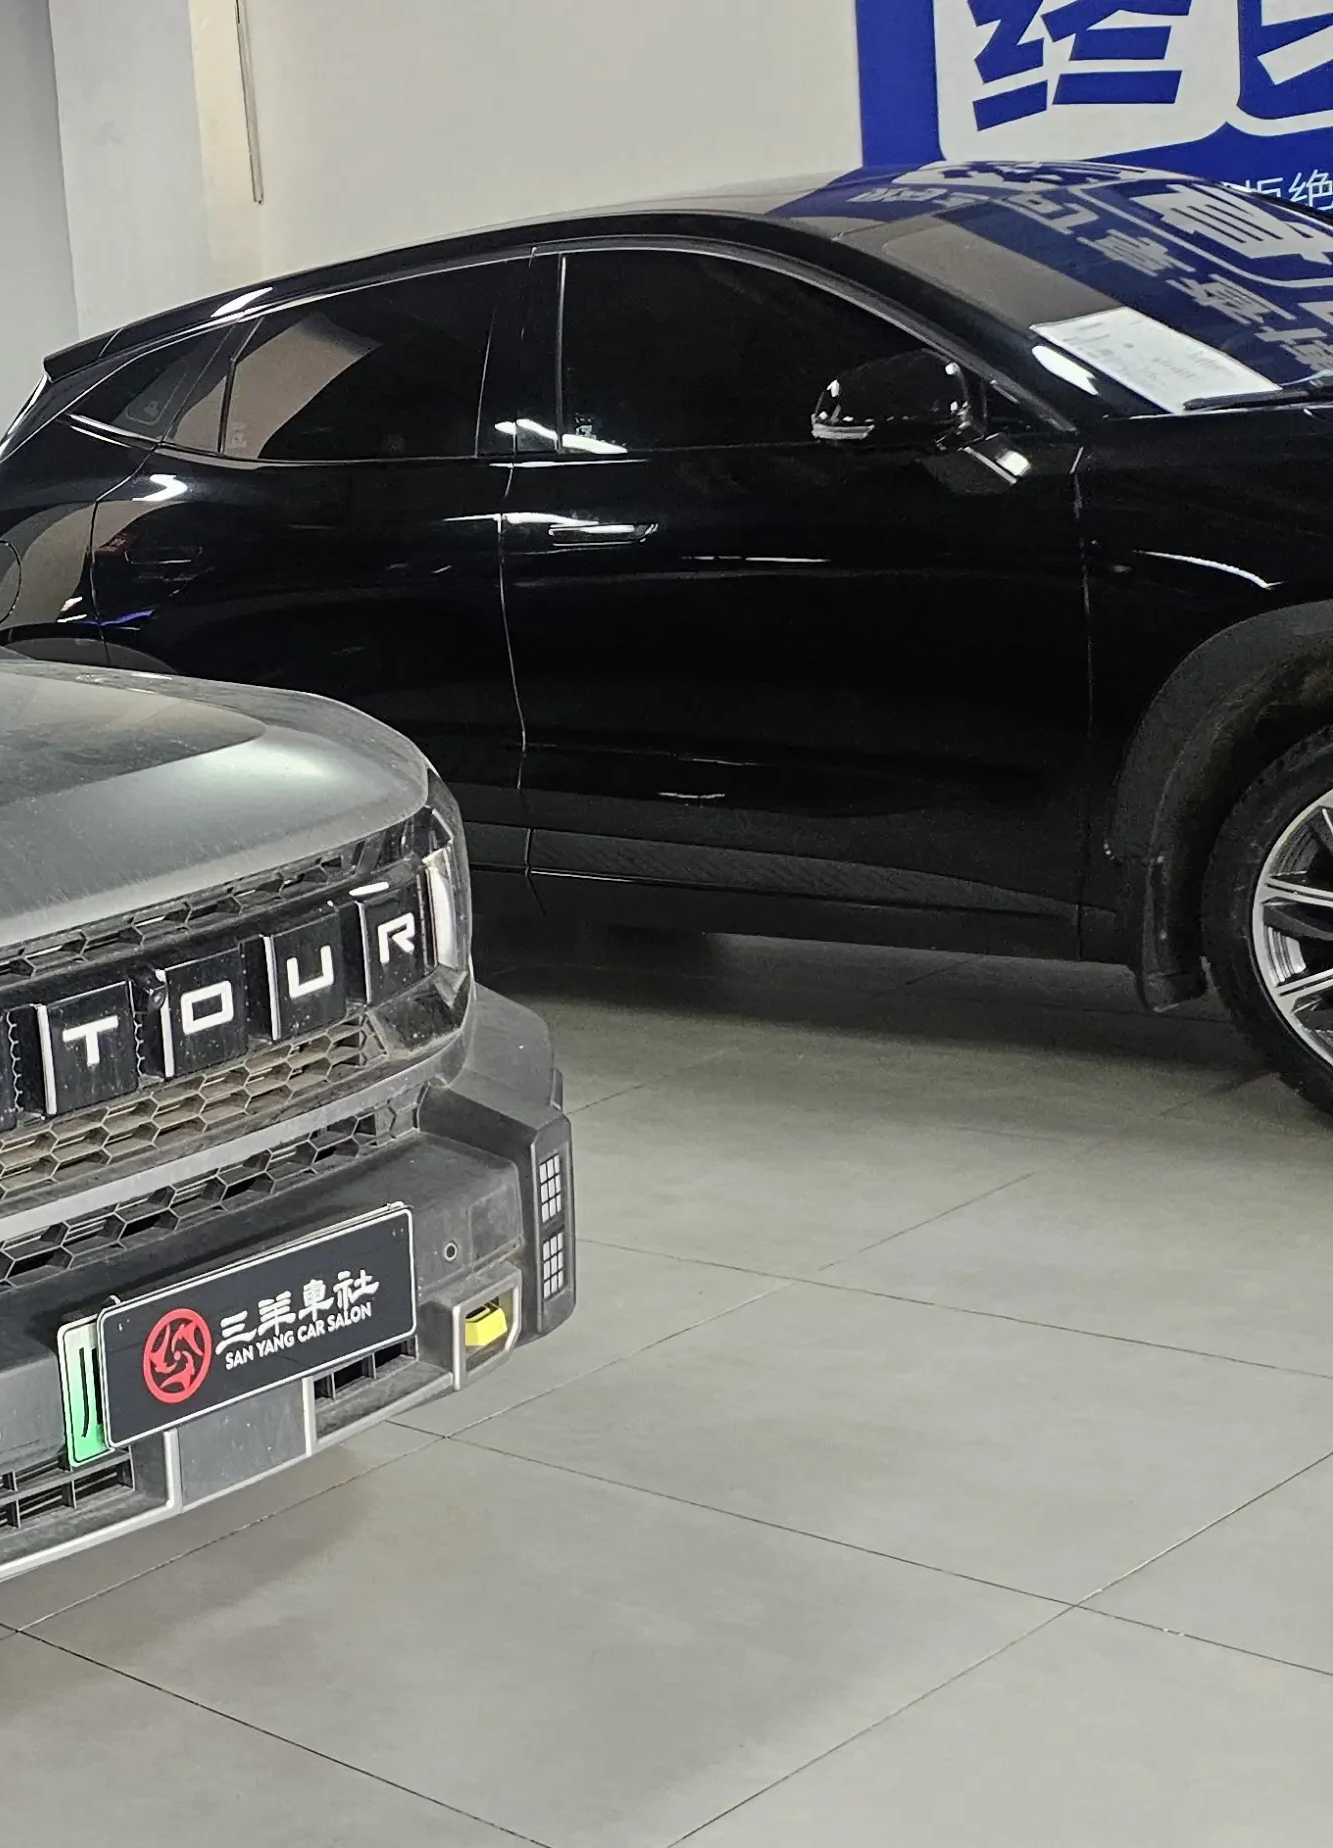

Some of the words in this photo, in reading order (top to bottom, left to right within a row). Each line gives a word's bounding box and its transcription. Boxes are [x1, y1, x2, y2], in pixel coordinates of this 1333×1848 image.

[225, 1345, 253, 1371] SAN
[256, 1331, 295, 1358] YANG
[298, 1320, 325, 1343] CAR
[328, 1302, 372, 1332] SALON
